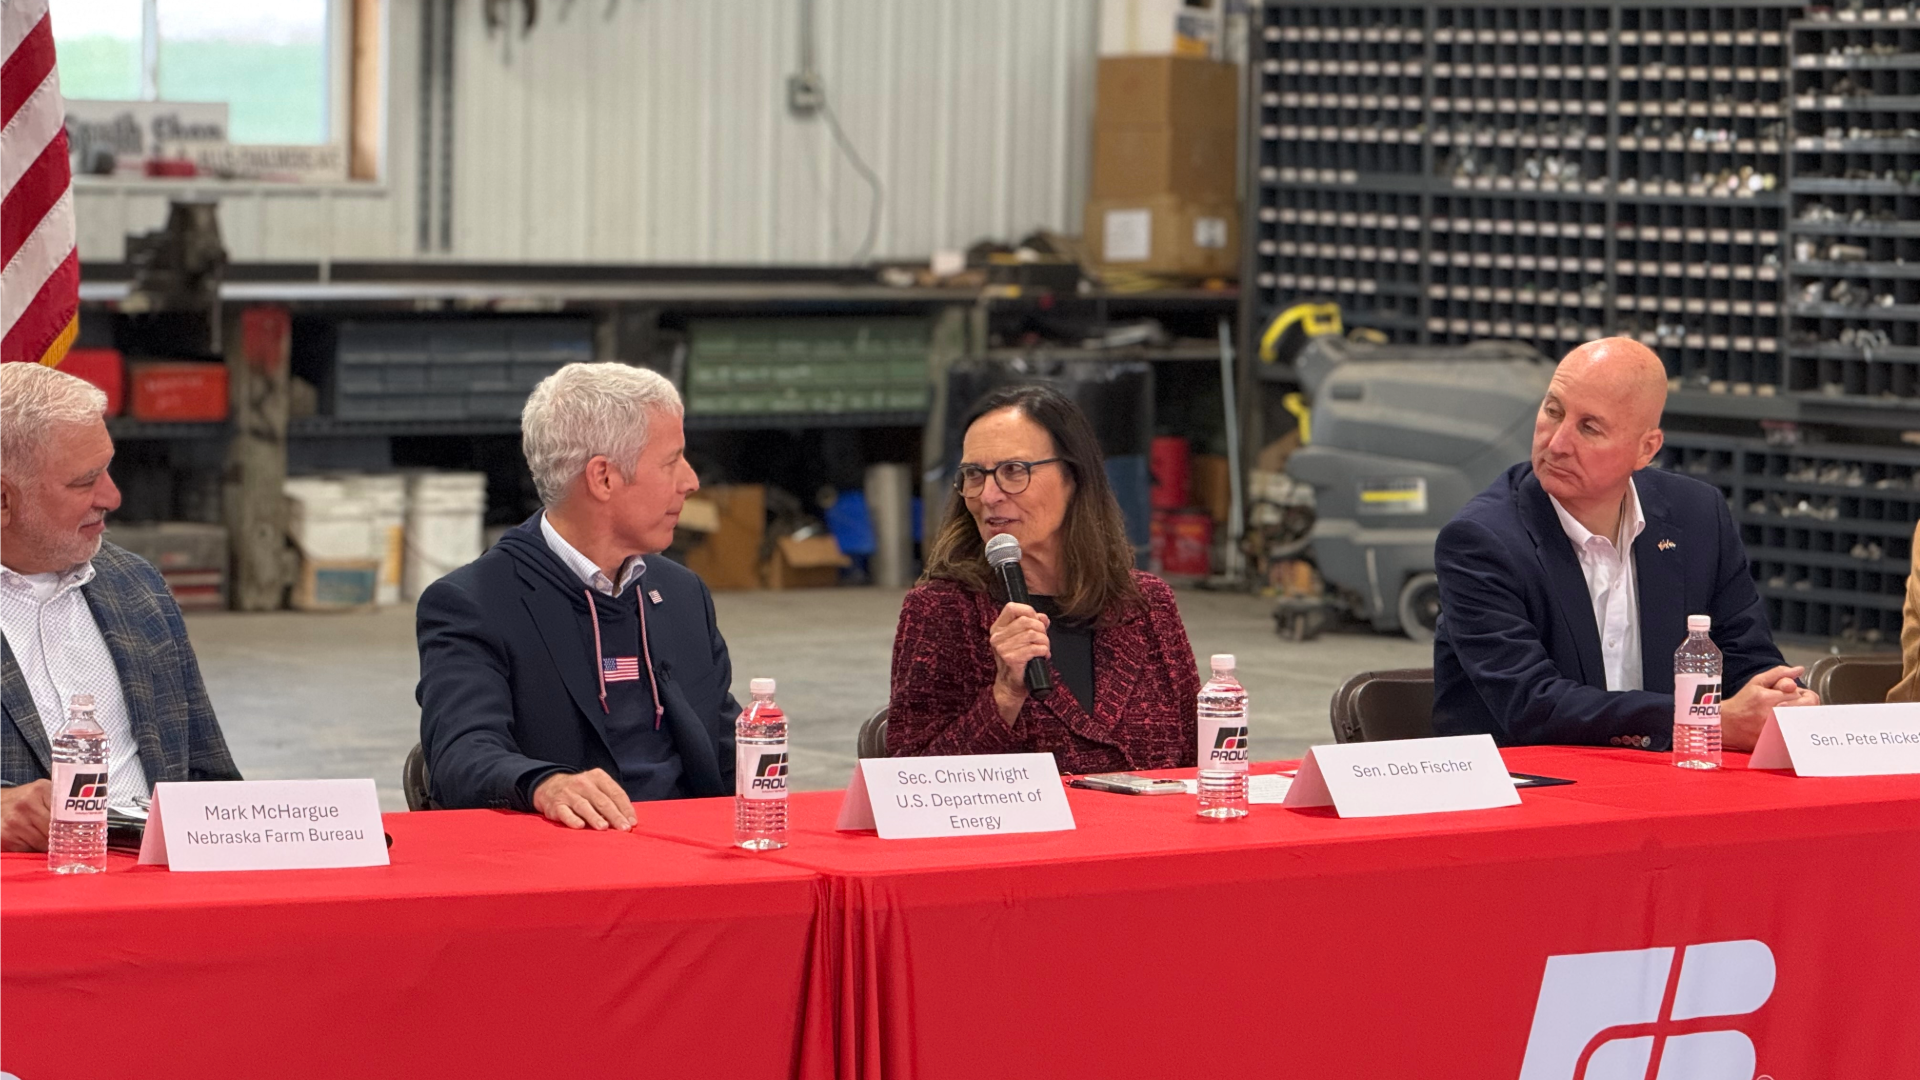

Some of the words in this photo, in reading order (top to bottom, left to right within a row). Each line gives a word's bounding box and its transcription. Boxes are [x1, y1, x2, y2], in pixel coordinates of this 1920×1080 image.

[1810, 733, 1844, 746] Sen.
[1845, 733, 1878, 746] Pete
[897, 770, 932, 785] Sec.
[934, 768, 976, 784] Chris
[977, 767, 1030, 784] Wright
[1352, 764, 1386, 778] Sen.
[1387, 762, 1418, 776] Deb
[1419, 760, 1473, 774] Fischer
[751, 778, 788, 790] PROU
[896, 793, 928, 808] U.S.
[930, 790, 1025, 809] Department
[1027, 788, 1042, 802] of
[204, 804, 249, 821] Mark
[251, 803, 340, 822] McHargue
[949, 815, 1002, 830] Energy
[187, 829, 261, 845] Nebraska
[264, 829, 305, 843] Farm
[308, 828, 364, 842] Bureau
